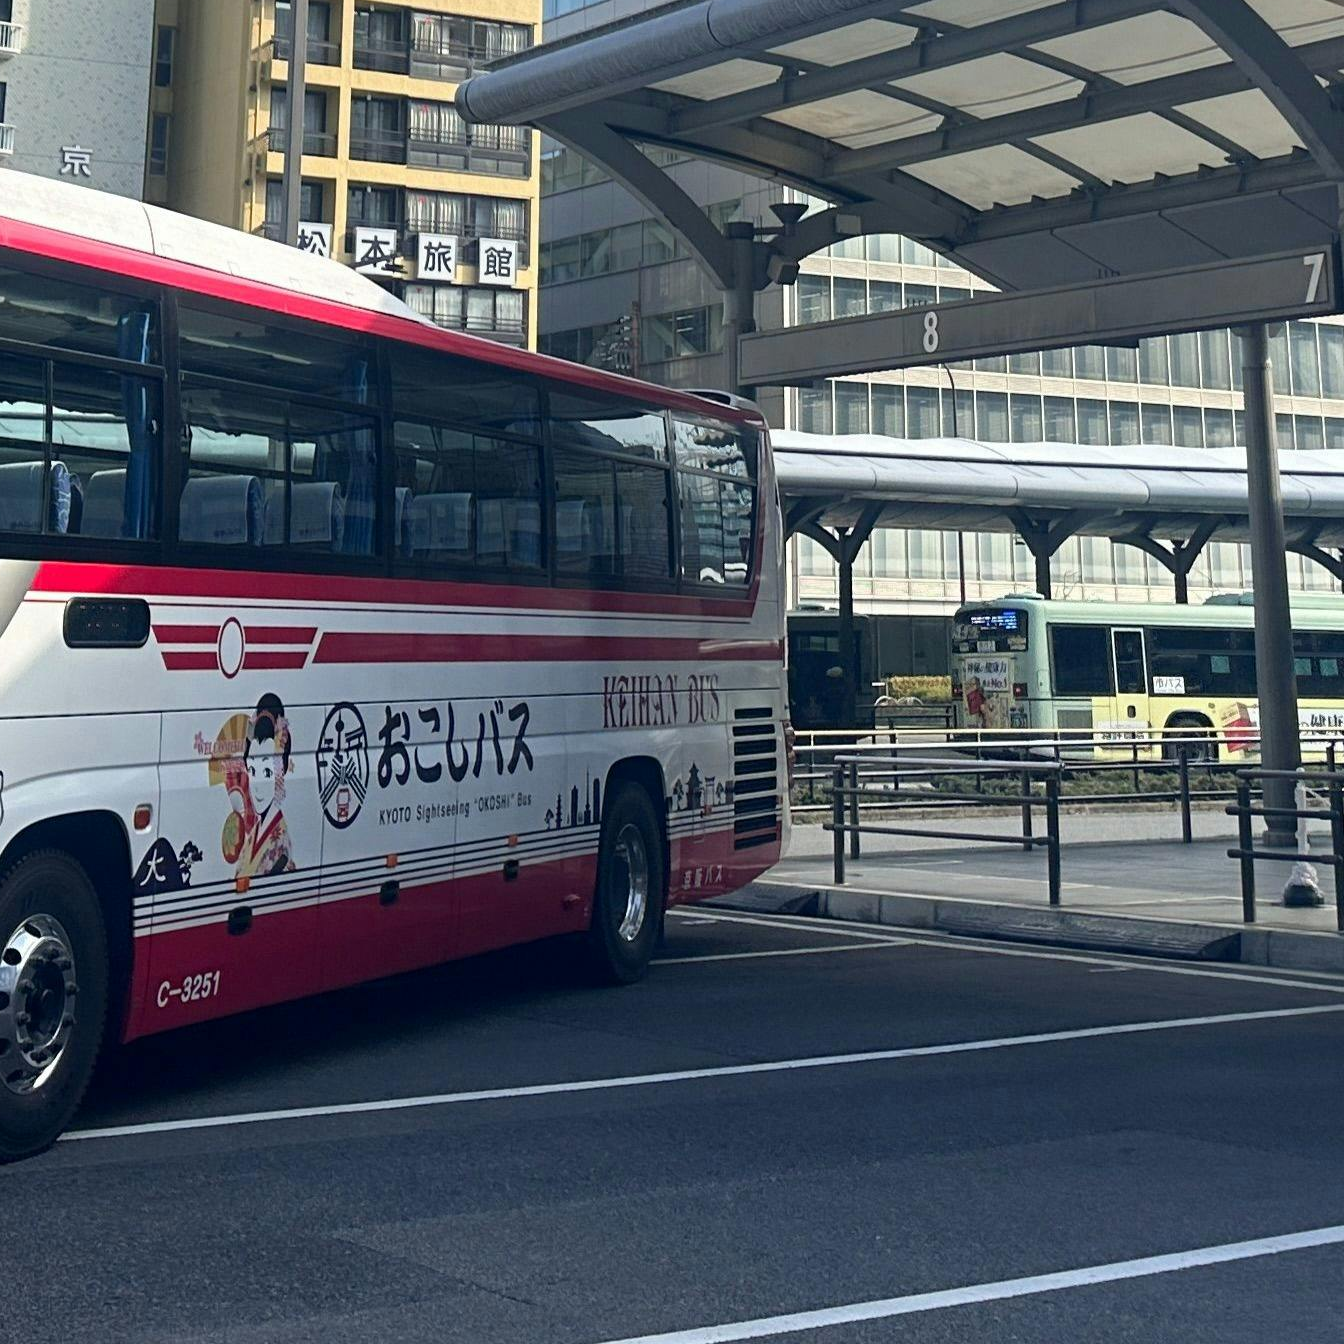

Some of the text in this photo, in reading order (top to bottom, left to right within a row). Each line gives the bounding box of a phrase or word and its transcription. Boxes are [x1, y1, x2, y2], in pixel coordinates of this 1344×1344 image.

[60, 145, 93, 176] 京
[298, 228, 514, 279] 松本旅館
[1302, 252, 1326, 304] 7
[922, 311, 940, 354] 8
[603, 674, 720, 729] KEIHAN BUS
[377, 699, 534, 790] おこしバス
[379, 806, 412, 826] KYOTO
[416, 800, 470, 824] Sightseeing
[517, 792, 532, 807] Bus
[140, 848, 166, 886] 大
[157, 970, 220, 1008] C-3251
